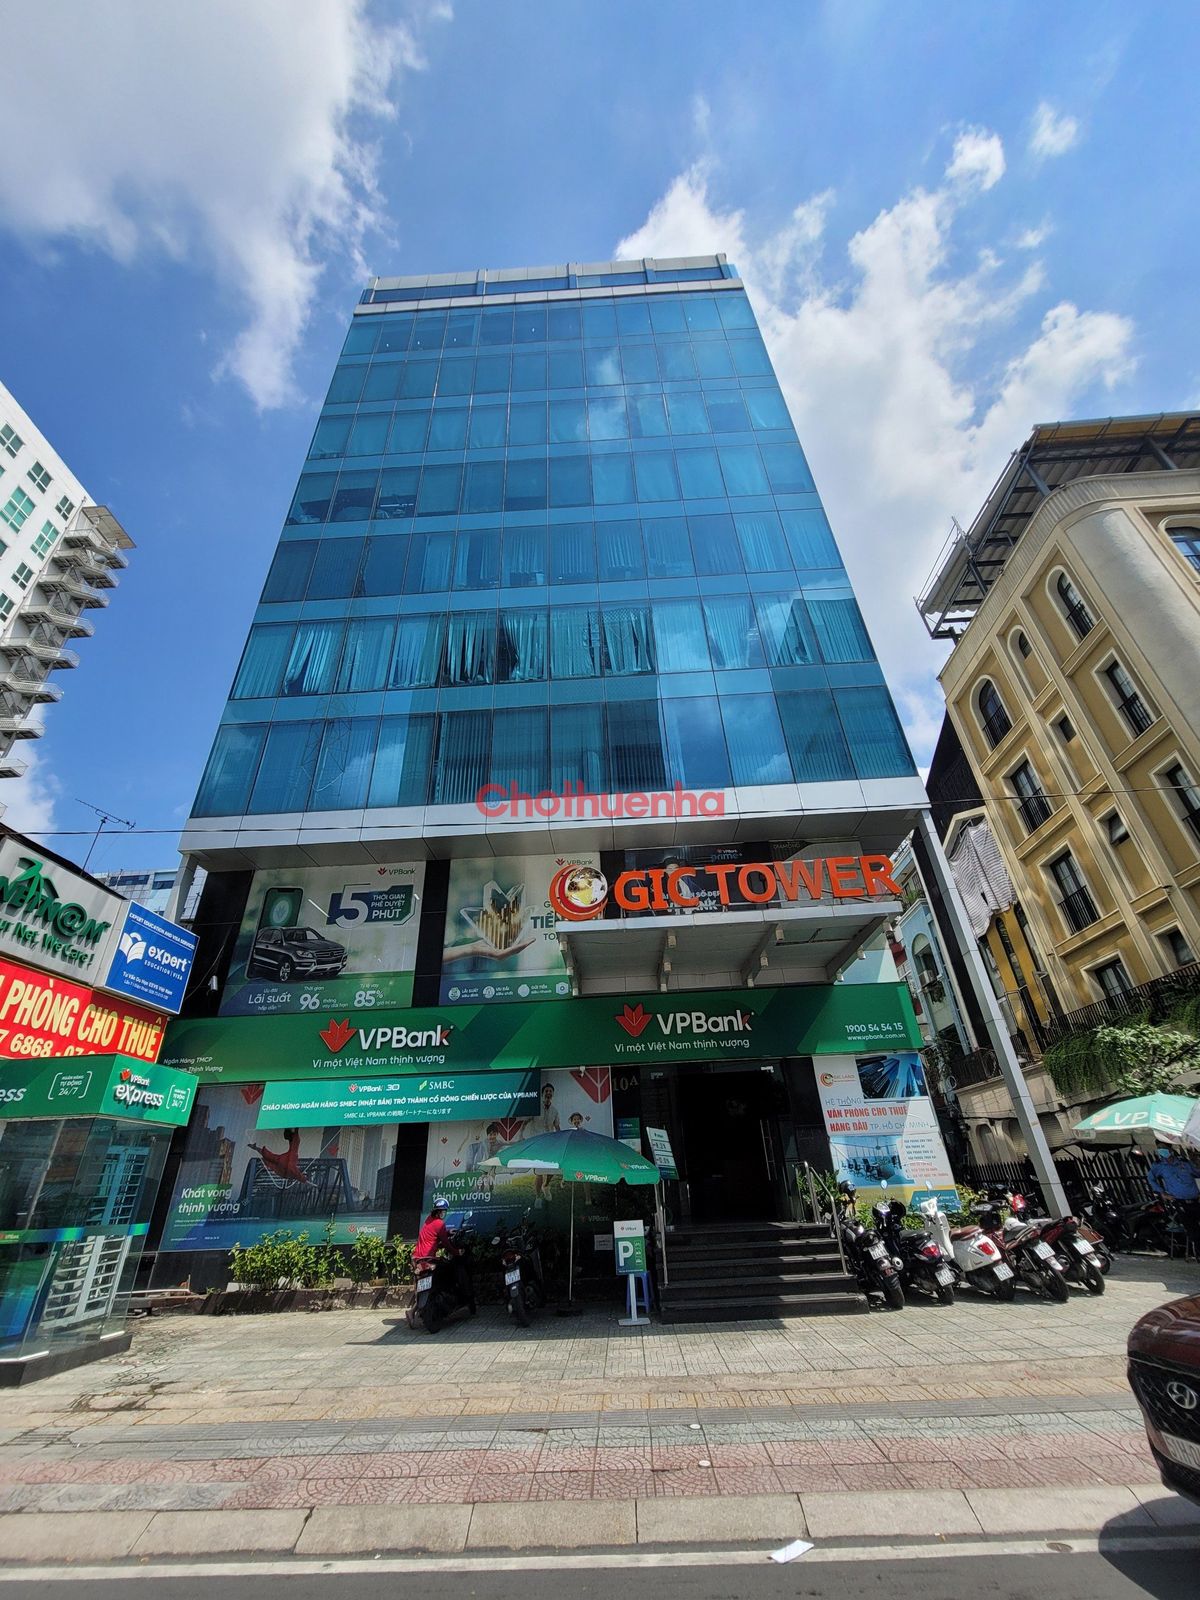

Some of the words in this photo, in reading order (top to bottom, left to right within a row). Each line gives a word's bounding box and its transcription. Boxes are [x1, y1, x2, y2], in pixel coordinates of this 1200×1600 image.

[389, 867, 416, 875] VPBank
[614, 867, 701, 911] GIC
[705, 854, 903, 905] TOWER
[335, 886, 368, 929] 5
[372, 907, 401, 919] PHÚT
[148, 945, 187, 972] expert
[144, 959, 170, 975] EDUCATION
[172, 972, 183, 981] VISA
[248, 992, 265, 1004] Lãi
[266, 991, 292, 1003] suất
[299, 993, 320, 1011] 96
[0, 979, 79, 1037] PHÒNG
[77, 1003, 118, 1047] CHO
[117, 1016, 162, 1059] THUÊ
[656, 1009, 752, 1034] VPBank
[845, 1024, 866, 1033] 1900
[868, 1024, 880, 1032] 54
[881, 1023, 892, 1031] 54
[893, 1022, 904, 1031] 15
[359, 1025, 450, 1050] VPBank
[847, 1033, 906, 1041] www.vpbank.com.vn
[10, 1033, 53, 1057] 6868
[614, 1043, 625, 1053] Vì
[627, 1043, 645, 1054] một
[647, 1041, 666, 1052] Việt
[669, 1041, 691, 1050] Nam
[693, 1039, 717, 1051] thịnh
[719, 1039, 750, 1049] vượng
[312, 1059, 321, 1068] Vì
[323, 1058, 342, 1070] một
[345, 1057, 363, 1069] Việt
[365, 1057, 388, 1066] Nam
[390, 1055, 414, 1066] thịnh
[415, 1054, 446, 1065] vượng
[130, 1074, 151, 1086] VPBank
[429, 1081, 455, 1090] SMBC
[58, 1087, 79, 1096] 24/7
[115, 1084, 165, 1107] express
[281, 1102, 300, 1110] MỪNG
[301, 1101, 319, 1109] NGÂN
[408, 1096, 428, 1104] THÀNH
[440, 1095, 460, 1103] ĐÔNG
[461, 1093, 479, 1101] CHIẾN
[481, 1093, 497, 1101] LƯỢC
[498, 1092, 512, 1100] CỦA
[513, 1091, 538, 1099] VPBANK
[871, 1107, 887, 1116] CHO
[434, 1179, 443, 1189] Vì
[446, 1178, 464, 1190] một
[467, 1177, 487, 1189] Việt
[489, 1176, 513, 1185] Nam
[181, 1187, 205, 1199] Khát
[207, 1189, 232, 1200] vọng
[460, 1191, 491, 1203] vượng
[178, 1202, 205, 1216] thịnh
[207, 1203, 240, 1215] vượng
[618, 1241, 634, 1267] P
